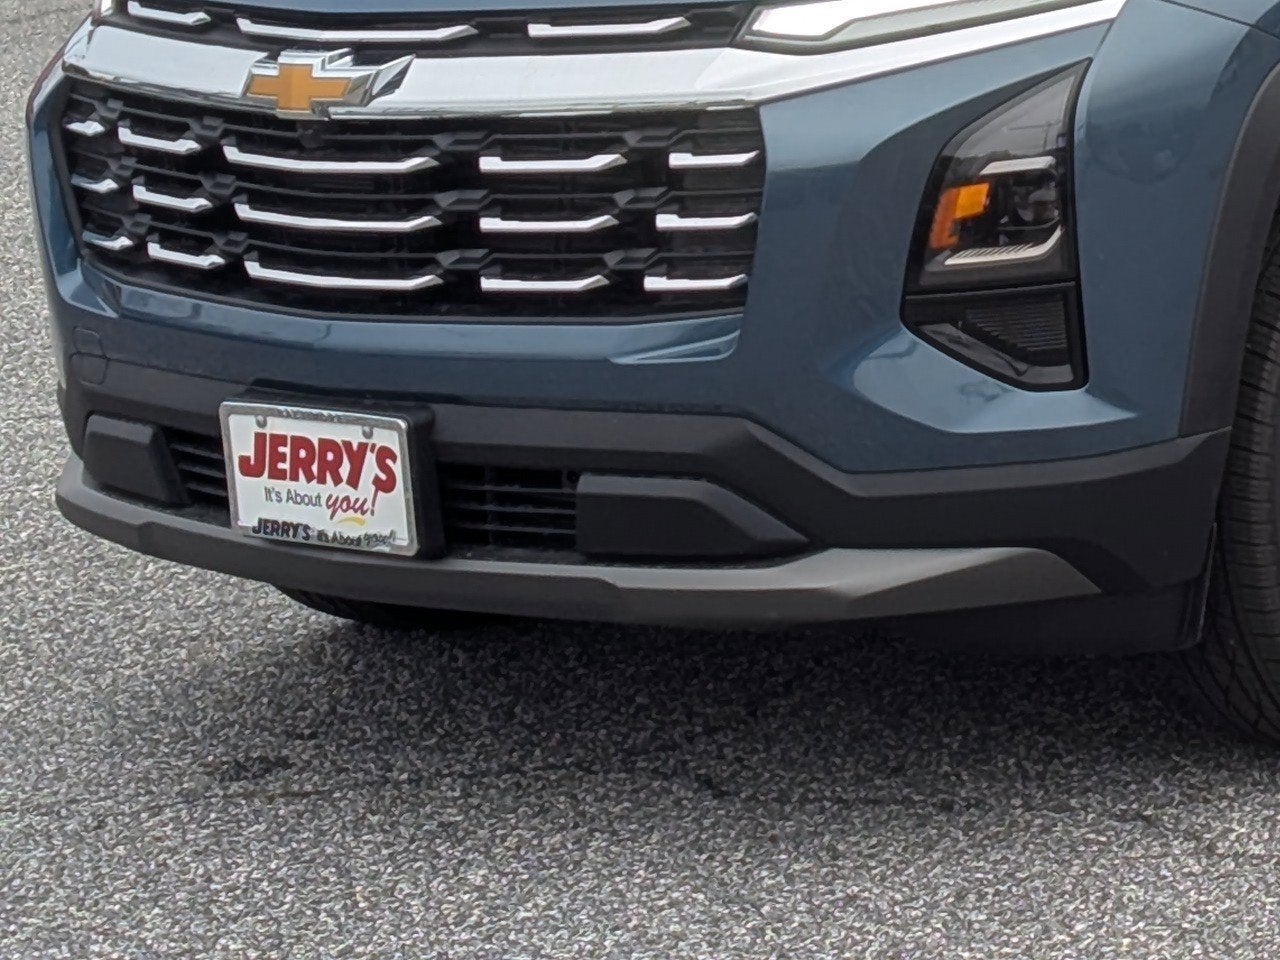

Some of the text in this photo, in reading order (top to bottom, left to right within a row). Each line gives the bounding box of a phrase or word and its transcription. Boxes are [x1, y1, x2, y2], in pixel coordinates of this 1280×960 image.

[238, 431, 397, 493] JERRY'S
[264, 486, 379, 521] It's About you!
[251, 517, 312, 541] JERRY'S
